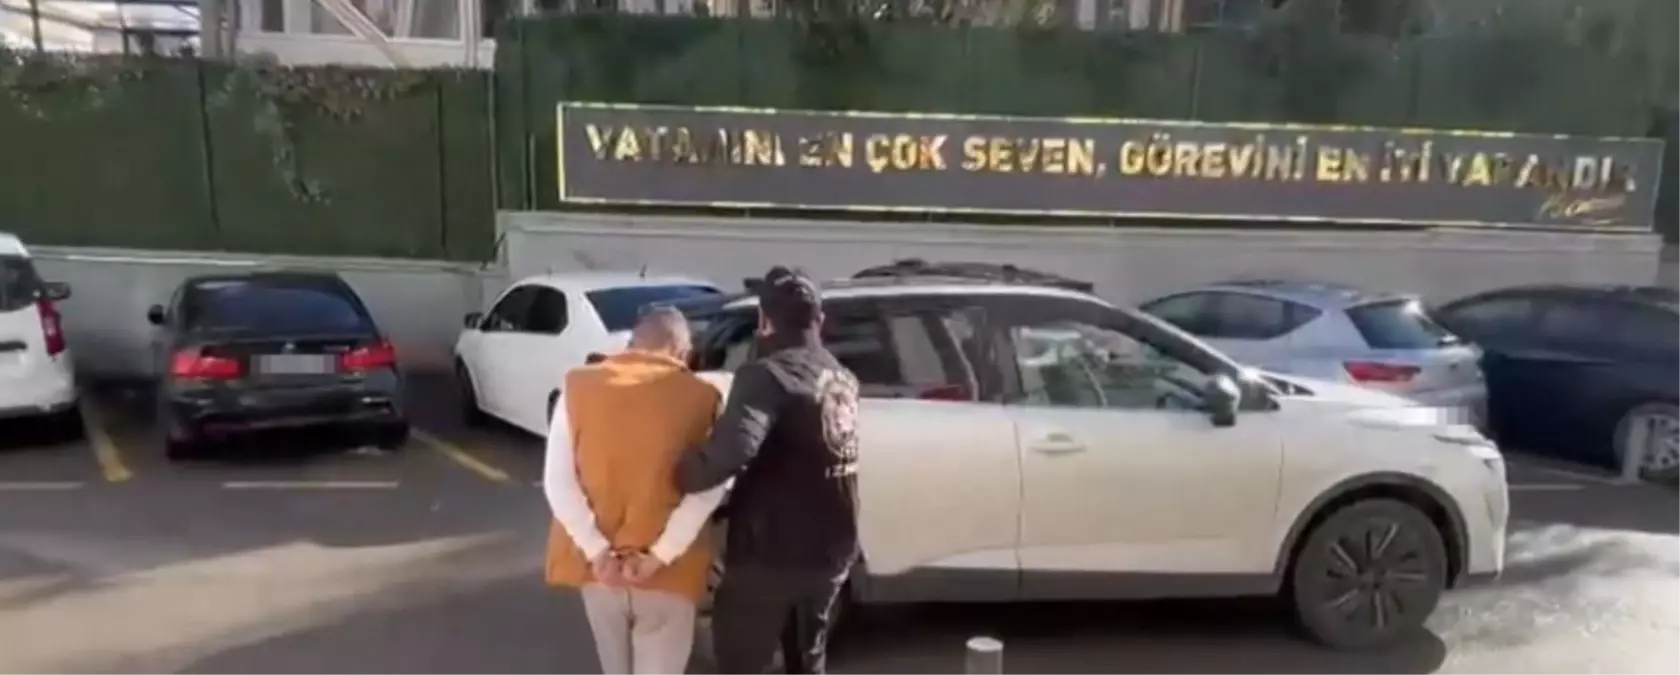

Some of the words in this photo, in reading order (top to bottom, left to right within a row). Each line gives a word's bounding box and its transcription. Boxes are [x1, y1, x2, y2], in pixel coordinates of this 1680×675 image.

[865, 132, 948, 174] ÇOK
[1119, 132, 1308, 181] GÖREVİNİ
[1316, 144, 1370, 182] EN
